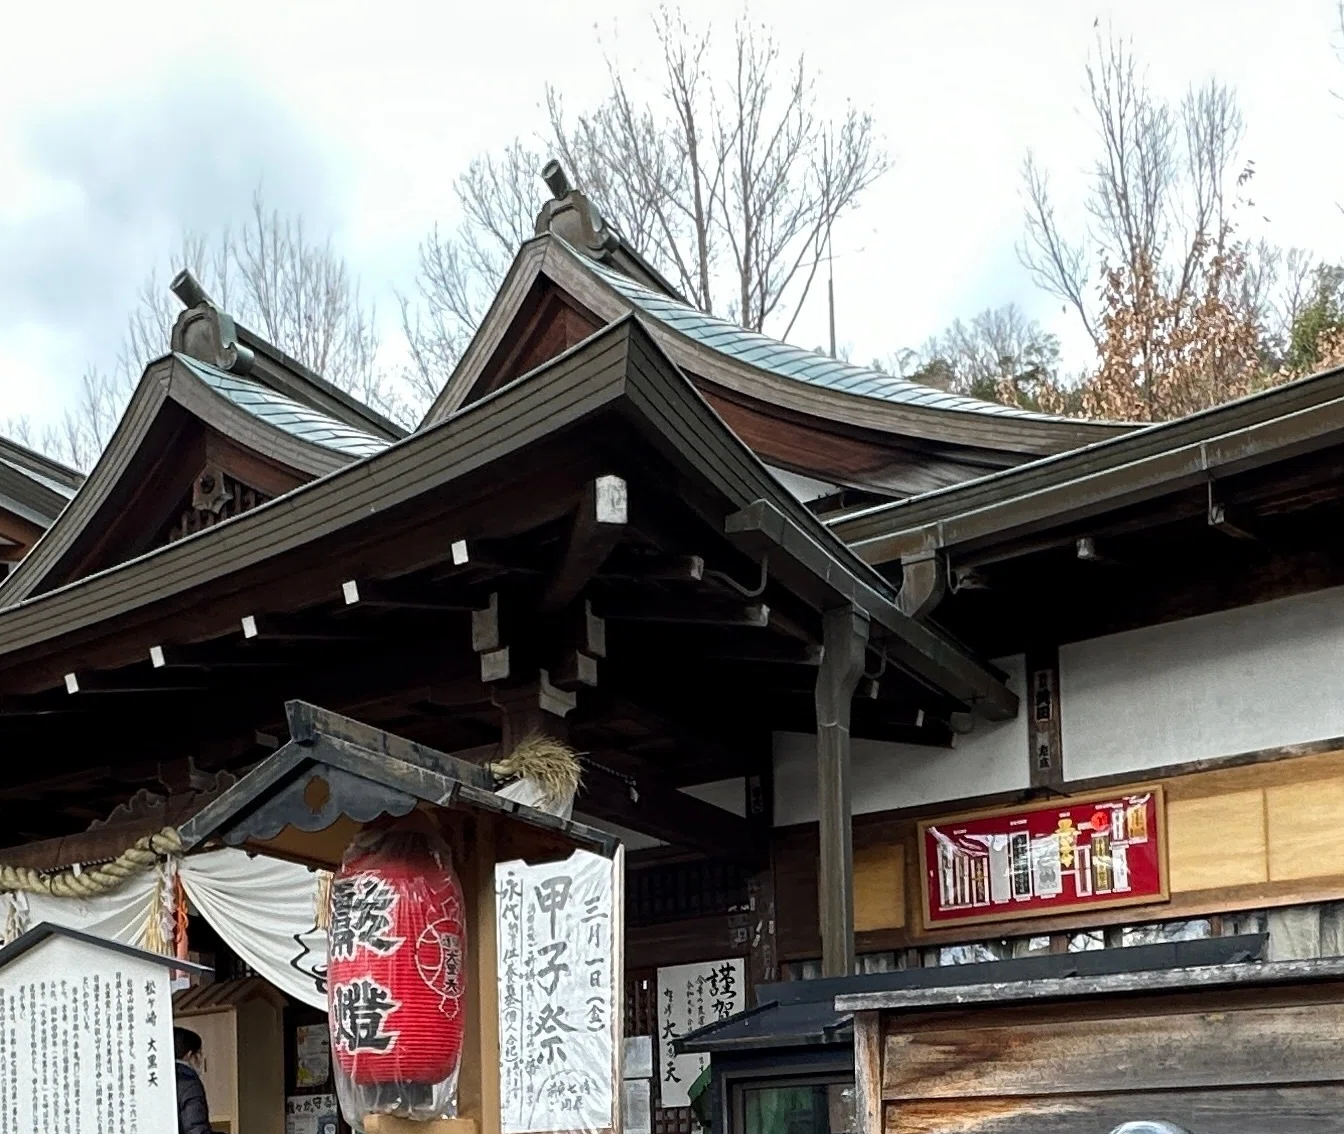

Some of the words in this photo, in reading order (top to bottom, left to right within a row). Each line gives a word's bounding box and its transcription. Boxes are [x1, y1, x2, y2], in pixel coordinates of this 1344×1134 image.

[533, 876, 577, 1065] 甲子祭
[147, 1036, 158, 1087] 大黒天
